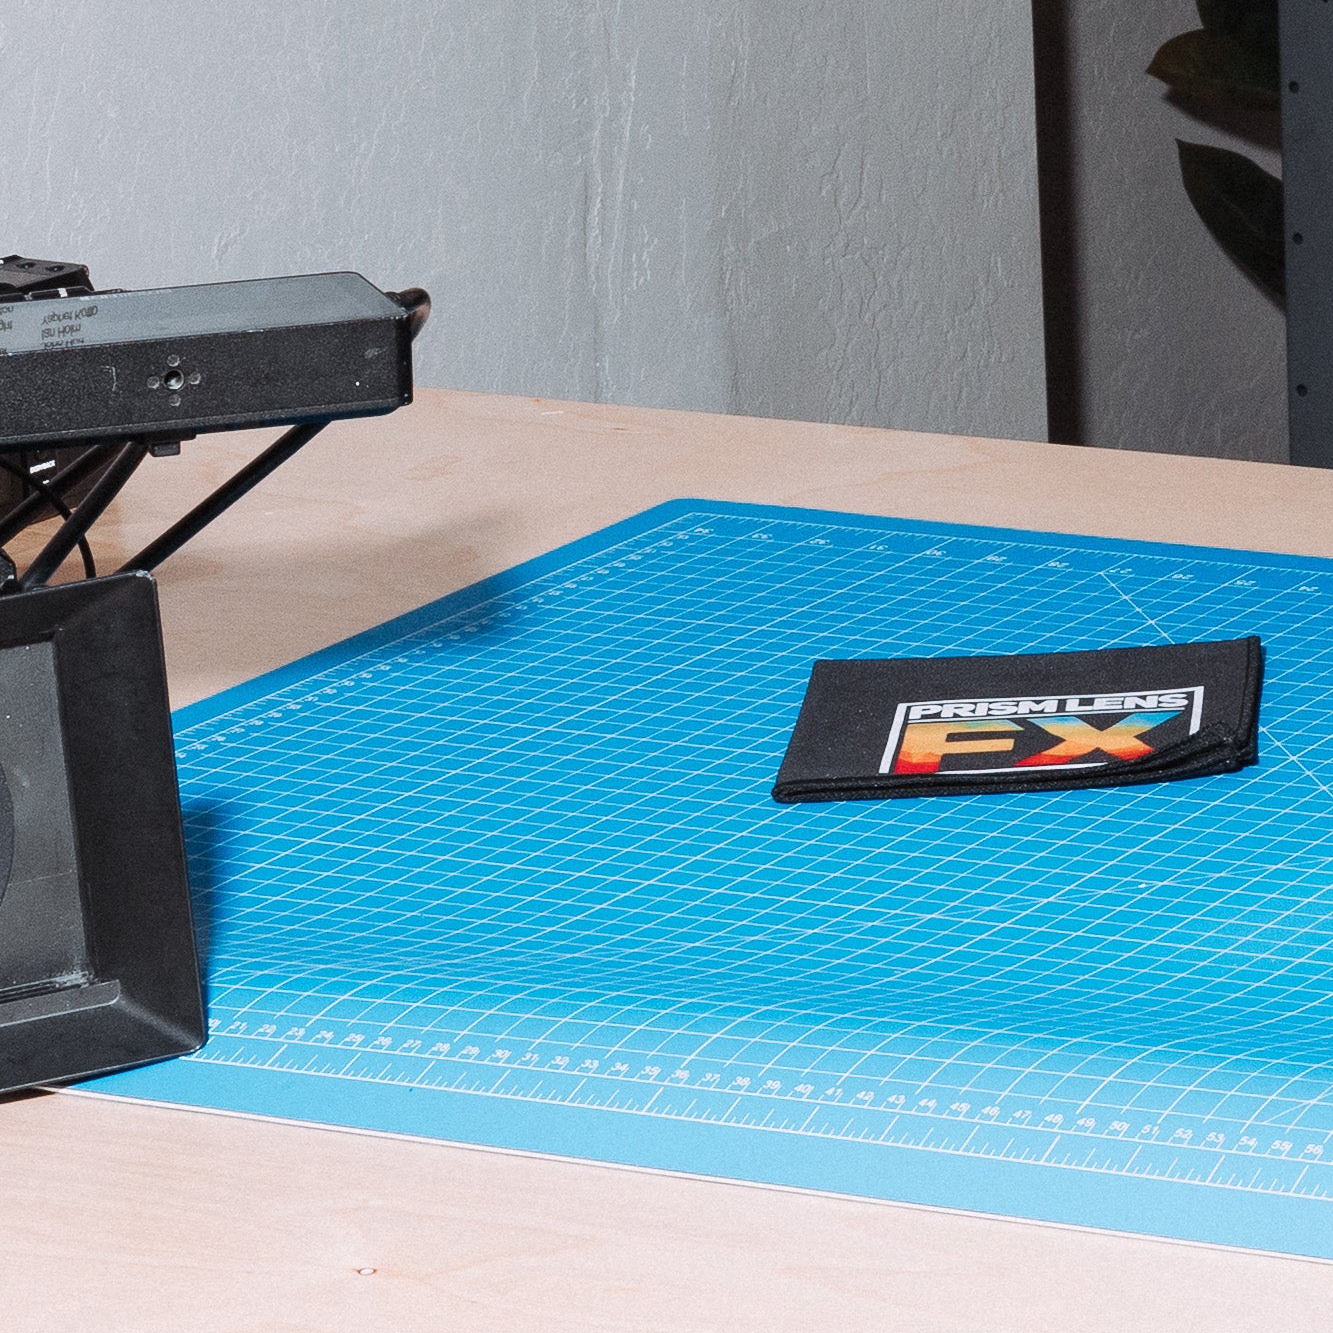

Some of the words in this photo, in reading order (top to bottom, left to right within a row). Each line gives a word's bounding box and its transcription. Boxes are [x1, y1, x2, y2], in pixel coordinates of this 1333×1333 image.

[908, 698, 1058, 721] PRISM
[1064, 692, 1190, 712] LENS
[894, 711, 1182, 775] FX
